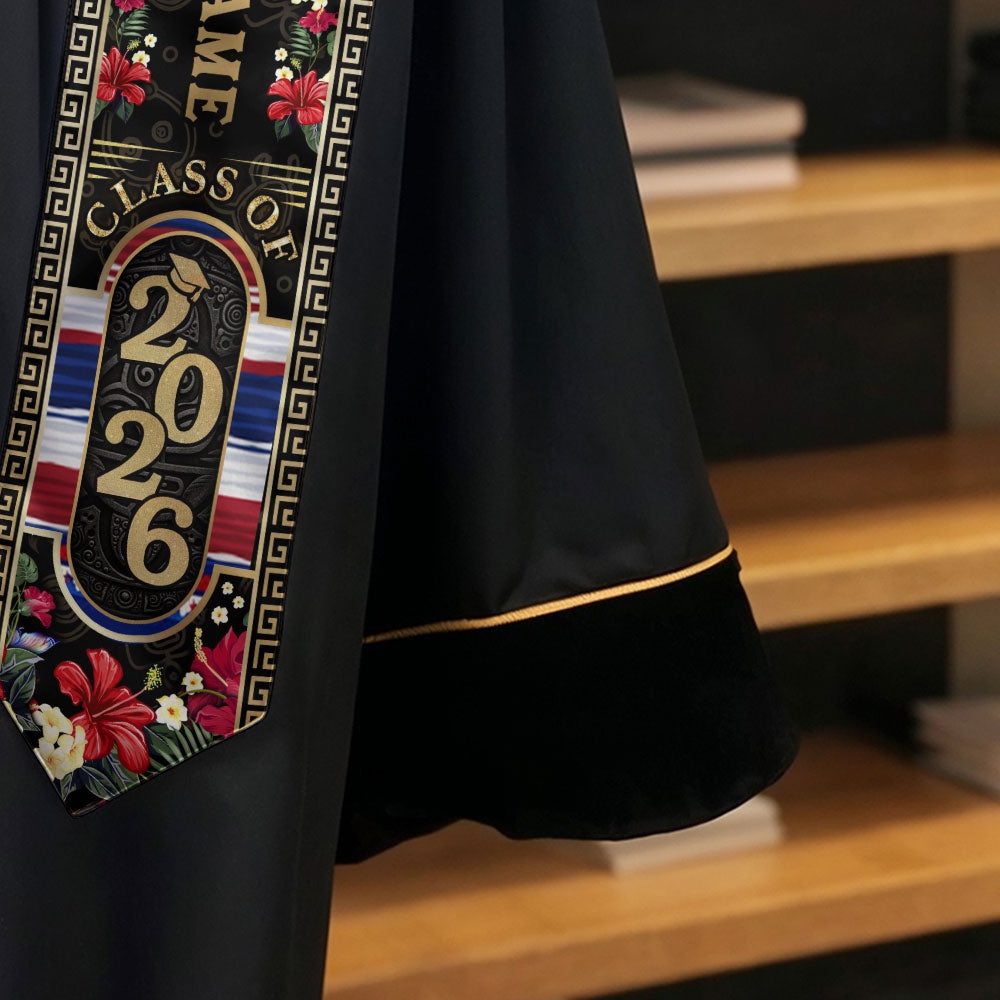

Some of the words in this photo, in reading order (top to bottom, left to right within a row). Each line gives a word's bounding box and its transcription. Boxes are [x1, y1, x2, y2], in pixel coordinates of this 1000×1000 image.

[86, 159, 239, 237] CLASS
[246, 194, 299, 261] OF
[97, 274, 224, 586] 2026
